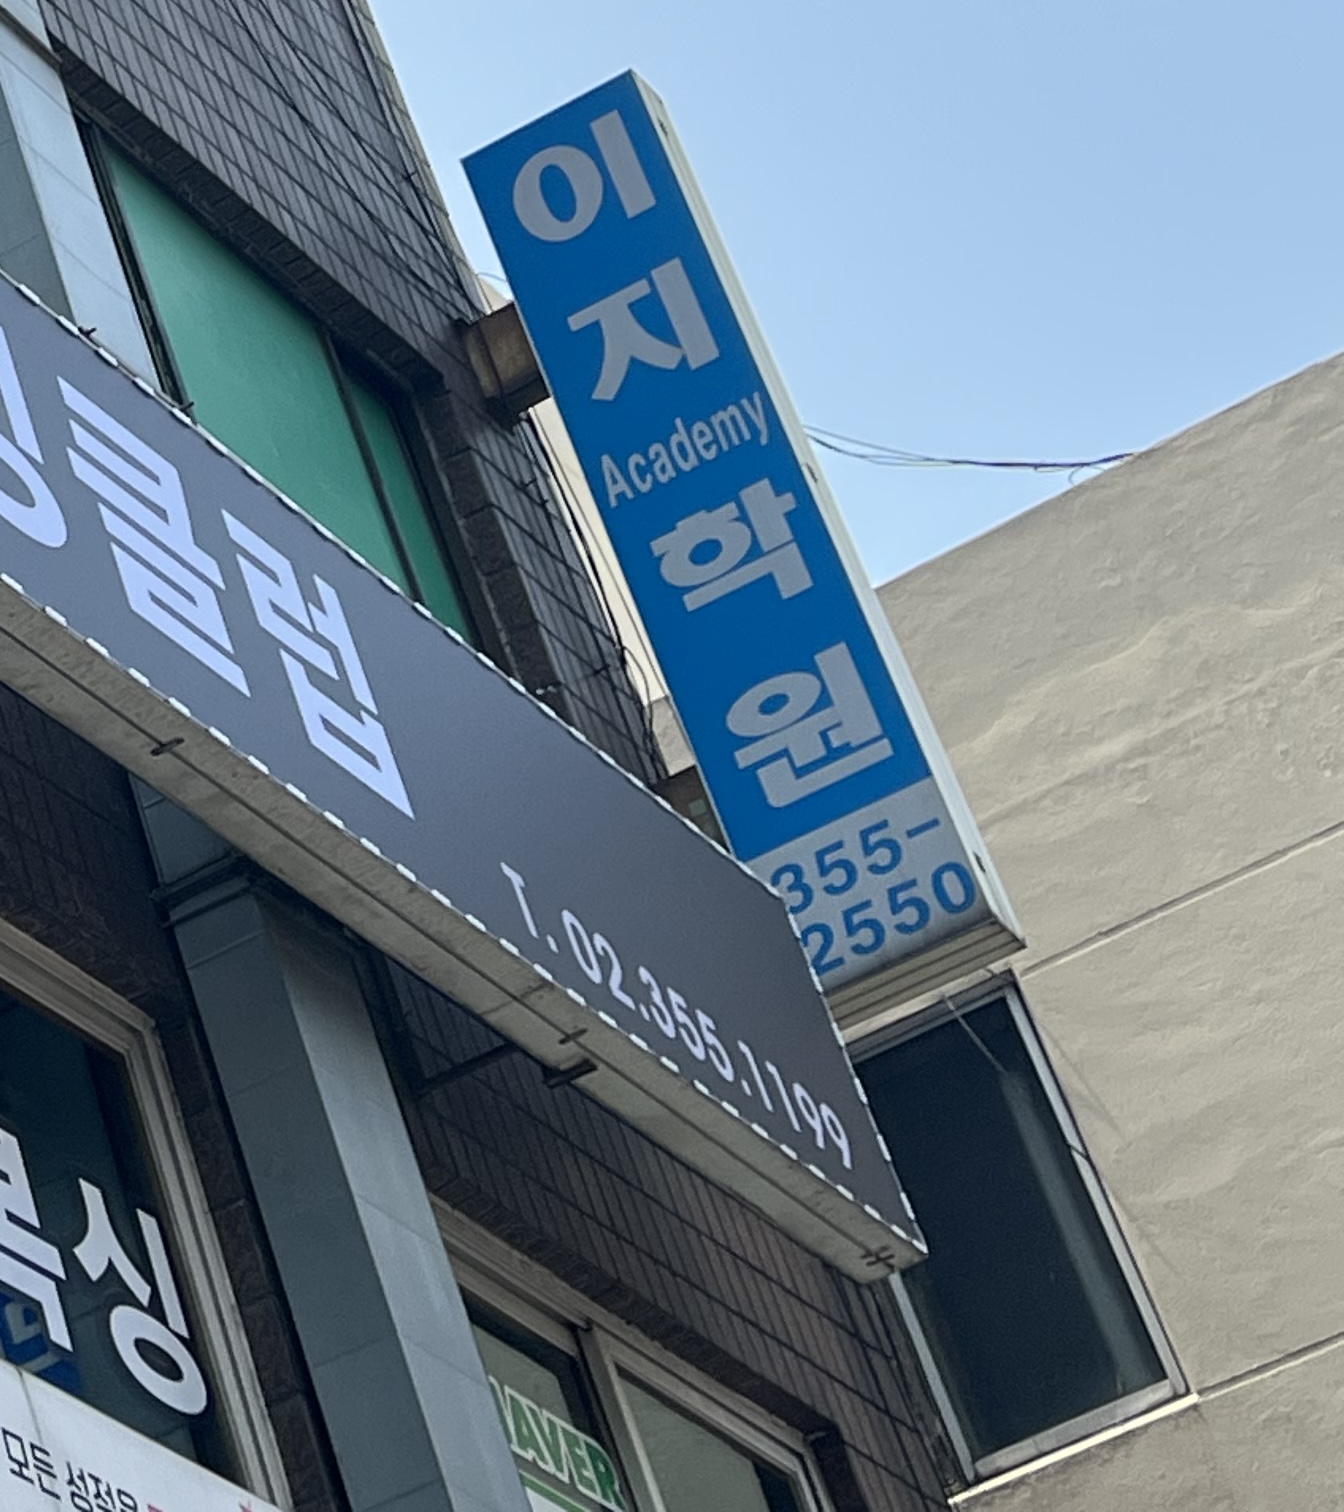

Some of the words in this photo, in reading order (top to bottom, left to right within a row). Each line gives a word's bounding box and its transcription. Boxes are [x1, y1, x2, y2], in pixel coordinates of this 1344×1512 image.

[601, 392, 769, 508] Academy
[803, 861, 977, 974] 2550
[0, 1426, 62, 1501] 모든
